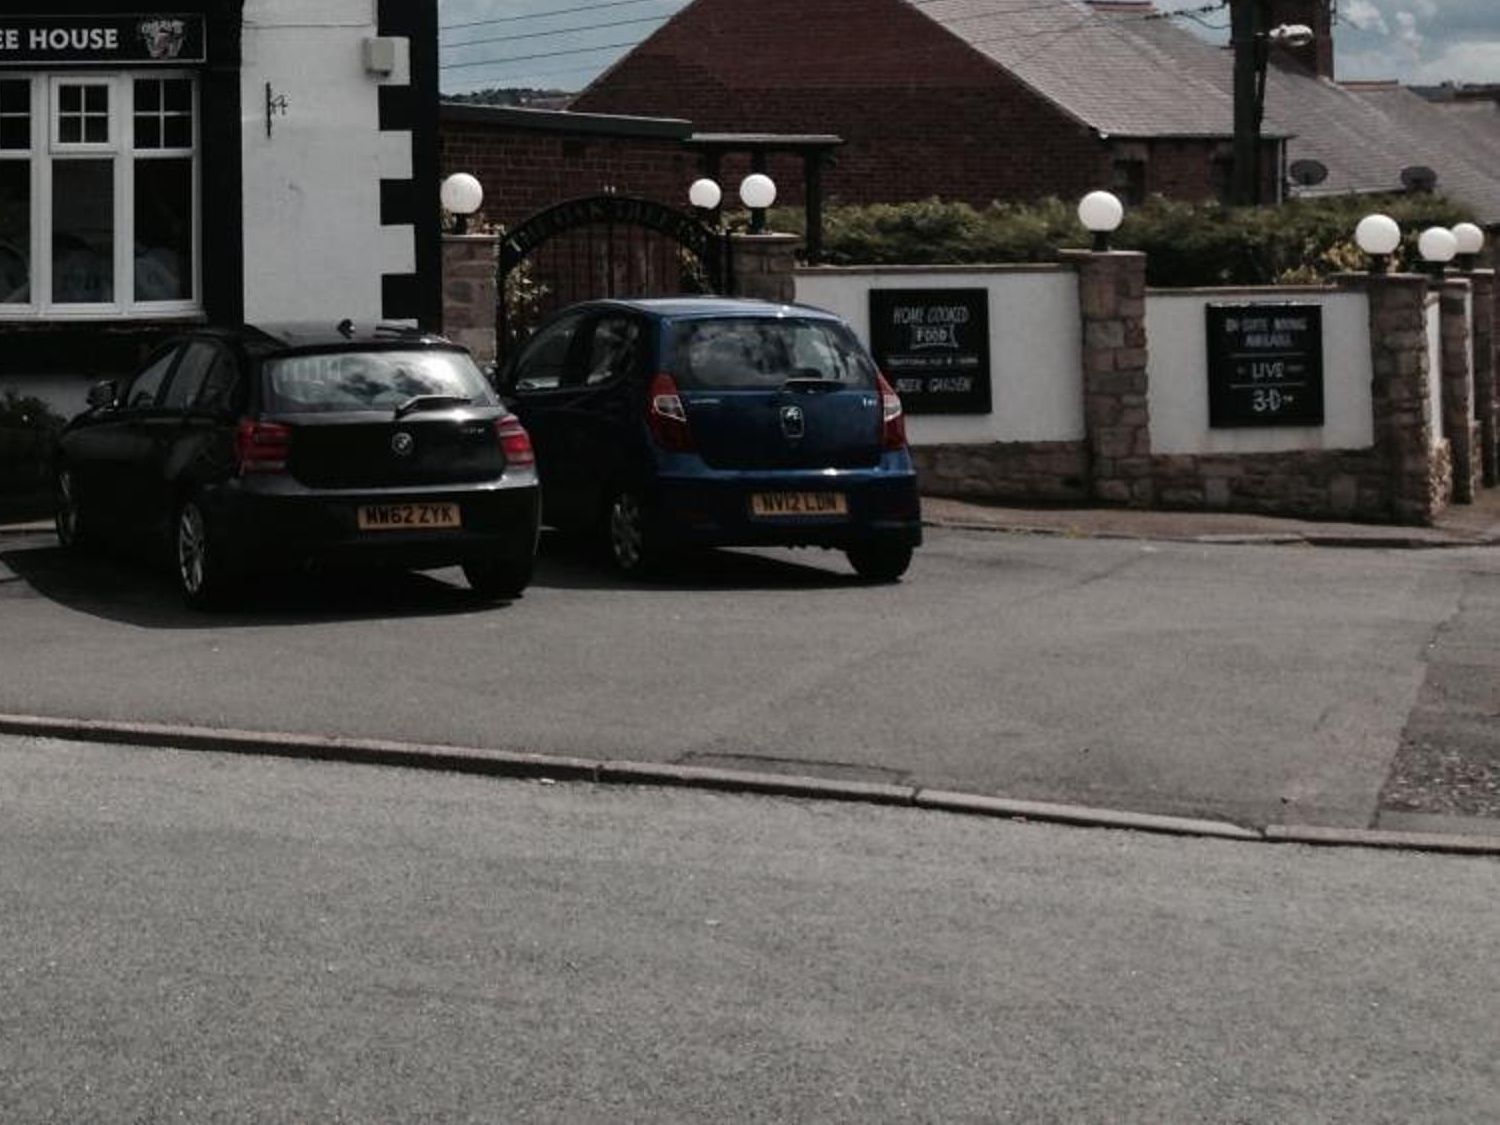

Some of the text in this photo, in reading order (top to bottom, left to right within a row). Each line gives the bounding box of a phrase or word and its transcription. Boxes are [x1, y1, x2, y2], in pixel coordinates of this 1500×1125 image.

[29, 28, 119, 50] HOUSE
[916, 327, 948, 342] FOOD
[1251, 362, 1284, 378] LIVE
[419, 506, 453, 523] ZYK
